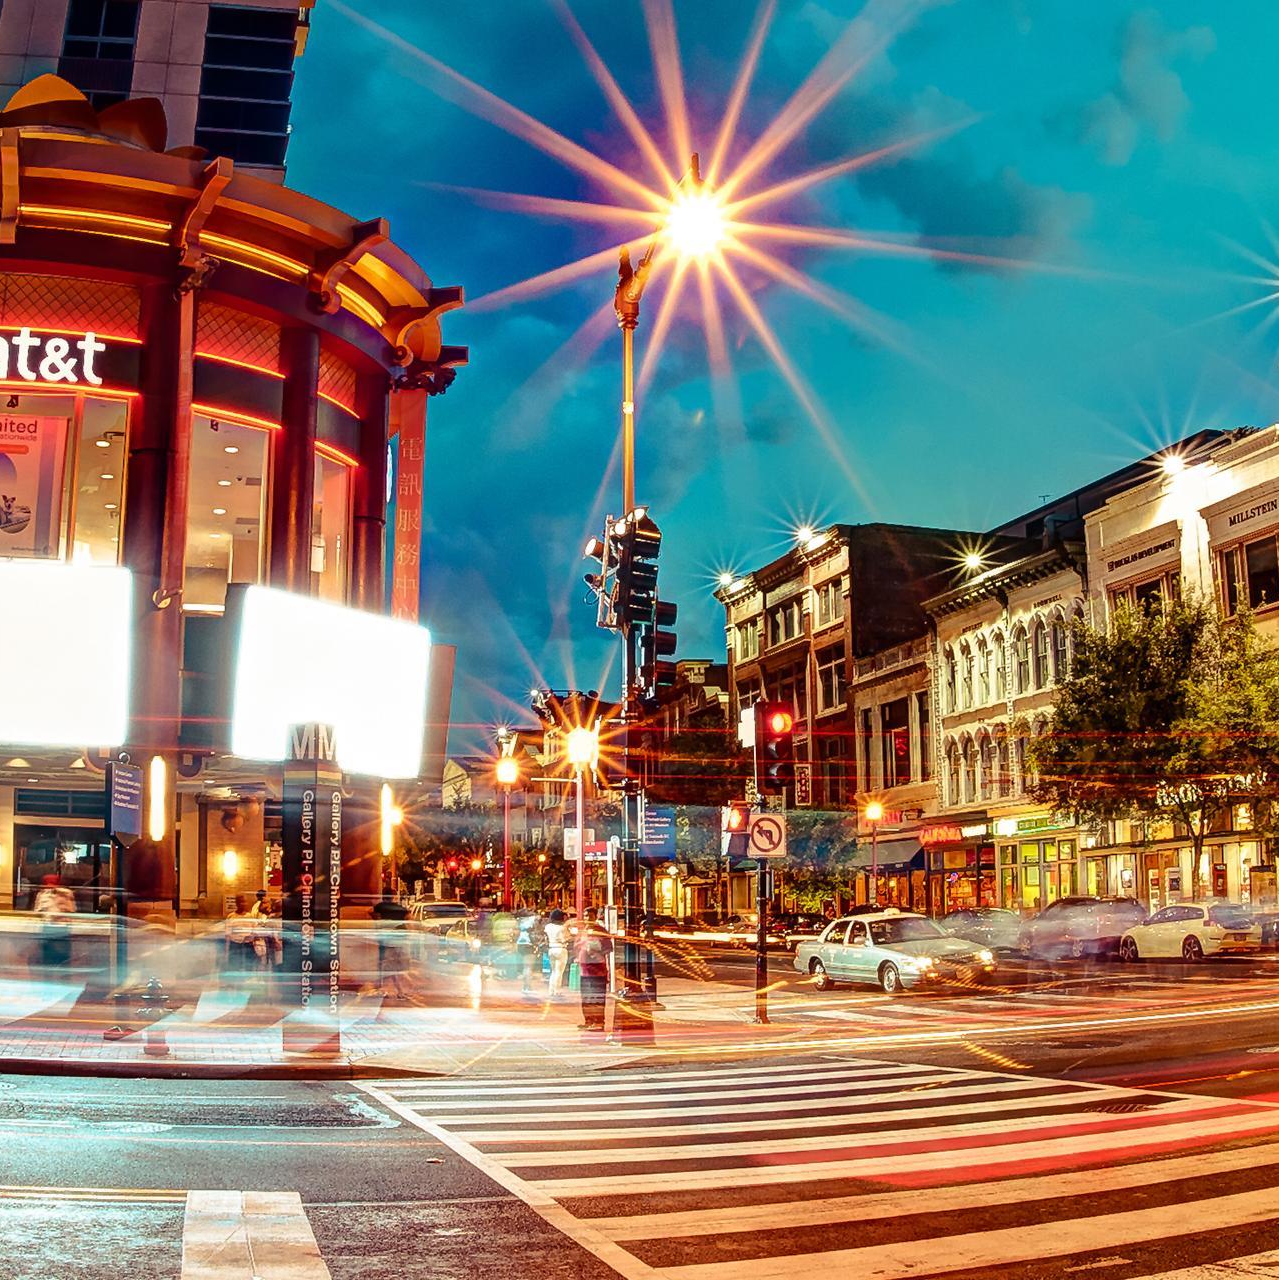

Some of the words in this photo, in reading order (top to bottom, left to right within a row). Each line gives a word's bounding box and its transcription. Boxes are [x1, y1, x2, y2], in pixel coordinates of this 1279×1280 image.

[1228, 499, 1279, 527] MILLSTEIN
[301, 789, 315, 845] Gallery
[329, 791, 342, 846] Gallery
[329, 959, 340, 1014] Station
